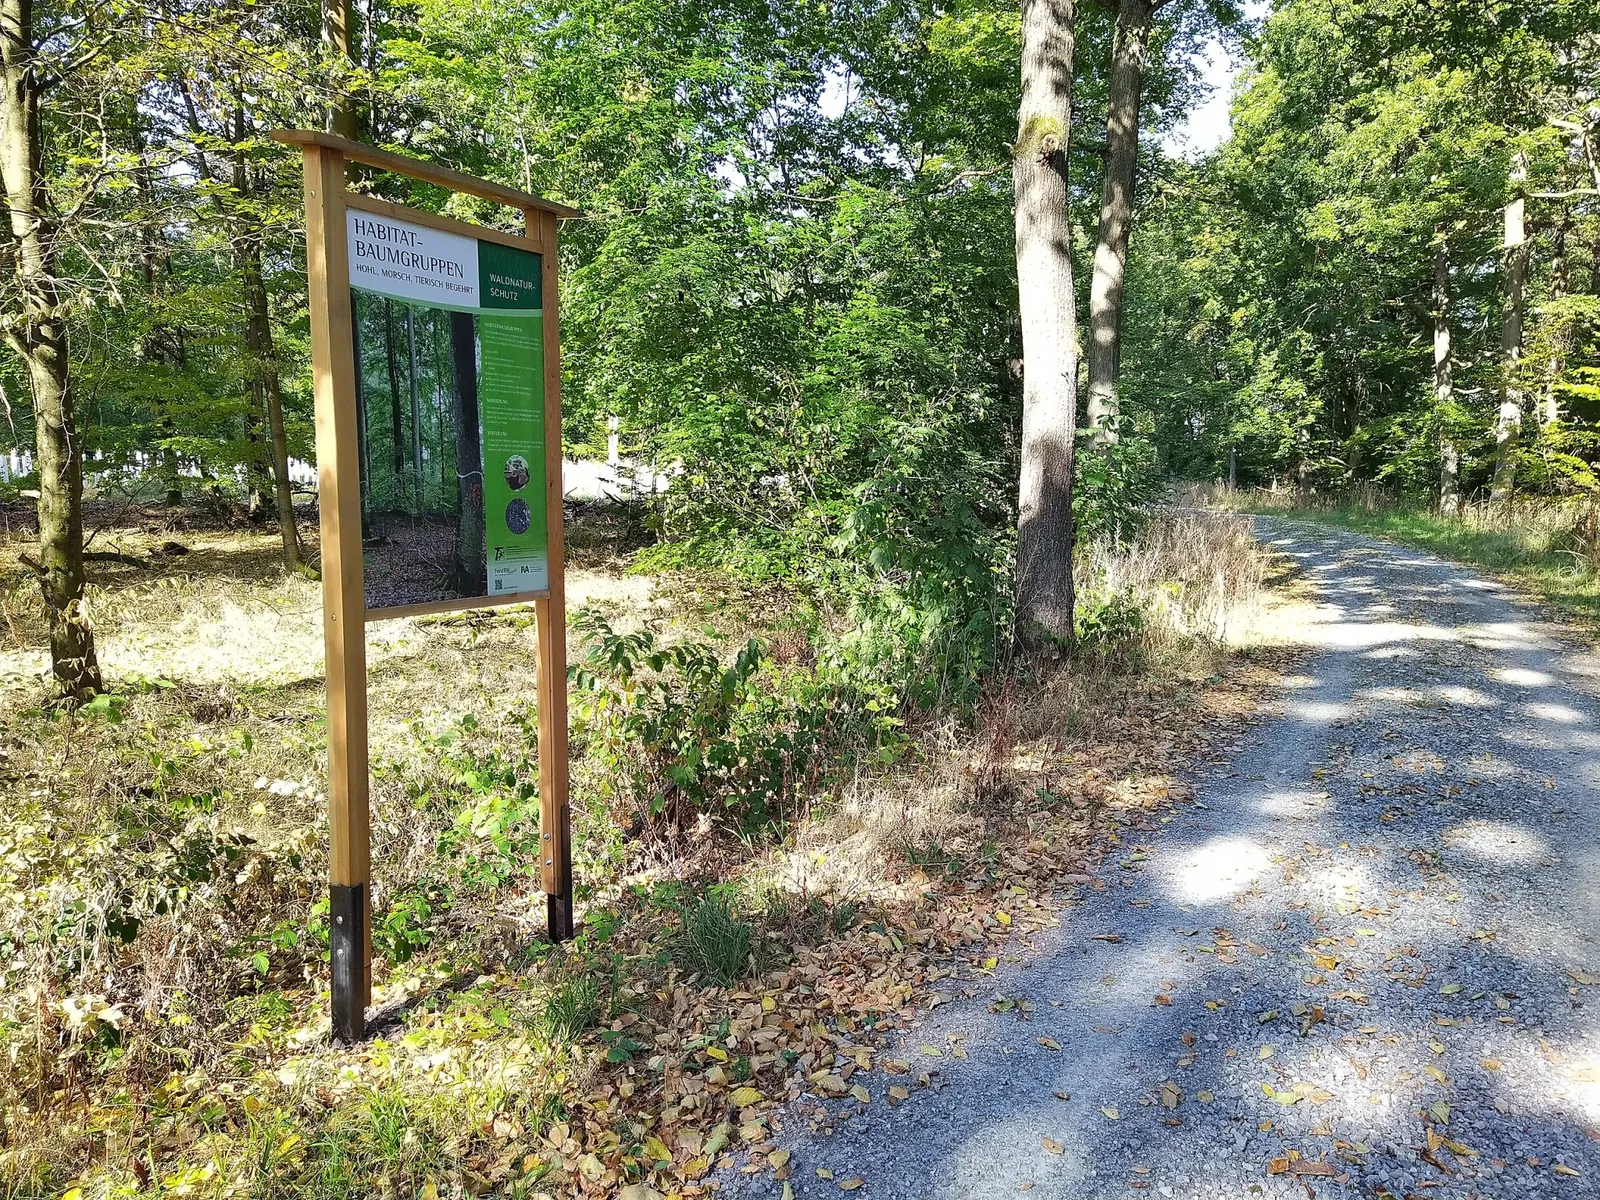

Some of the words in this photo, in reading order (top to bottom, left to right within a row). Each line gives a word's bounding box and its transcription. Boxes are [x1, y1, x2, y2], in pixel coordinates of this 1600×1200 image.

[354, 218, 424, 248] HABITAT-
[355, 240, 464, 279] BAUMGRUPPEN
[356, 263, 379, 277] HOHL,
[381, 268, 413, 283] MORSCH,
[414, 275, 444, 289] TIERISCH
[445, 282, 474, 295] BEGEHRT
[489, 272, 536, 290] WALDNATUR-
[490, 287, 518, 301] SCHUTZ
